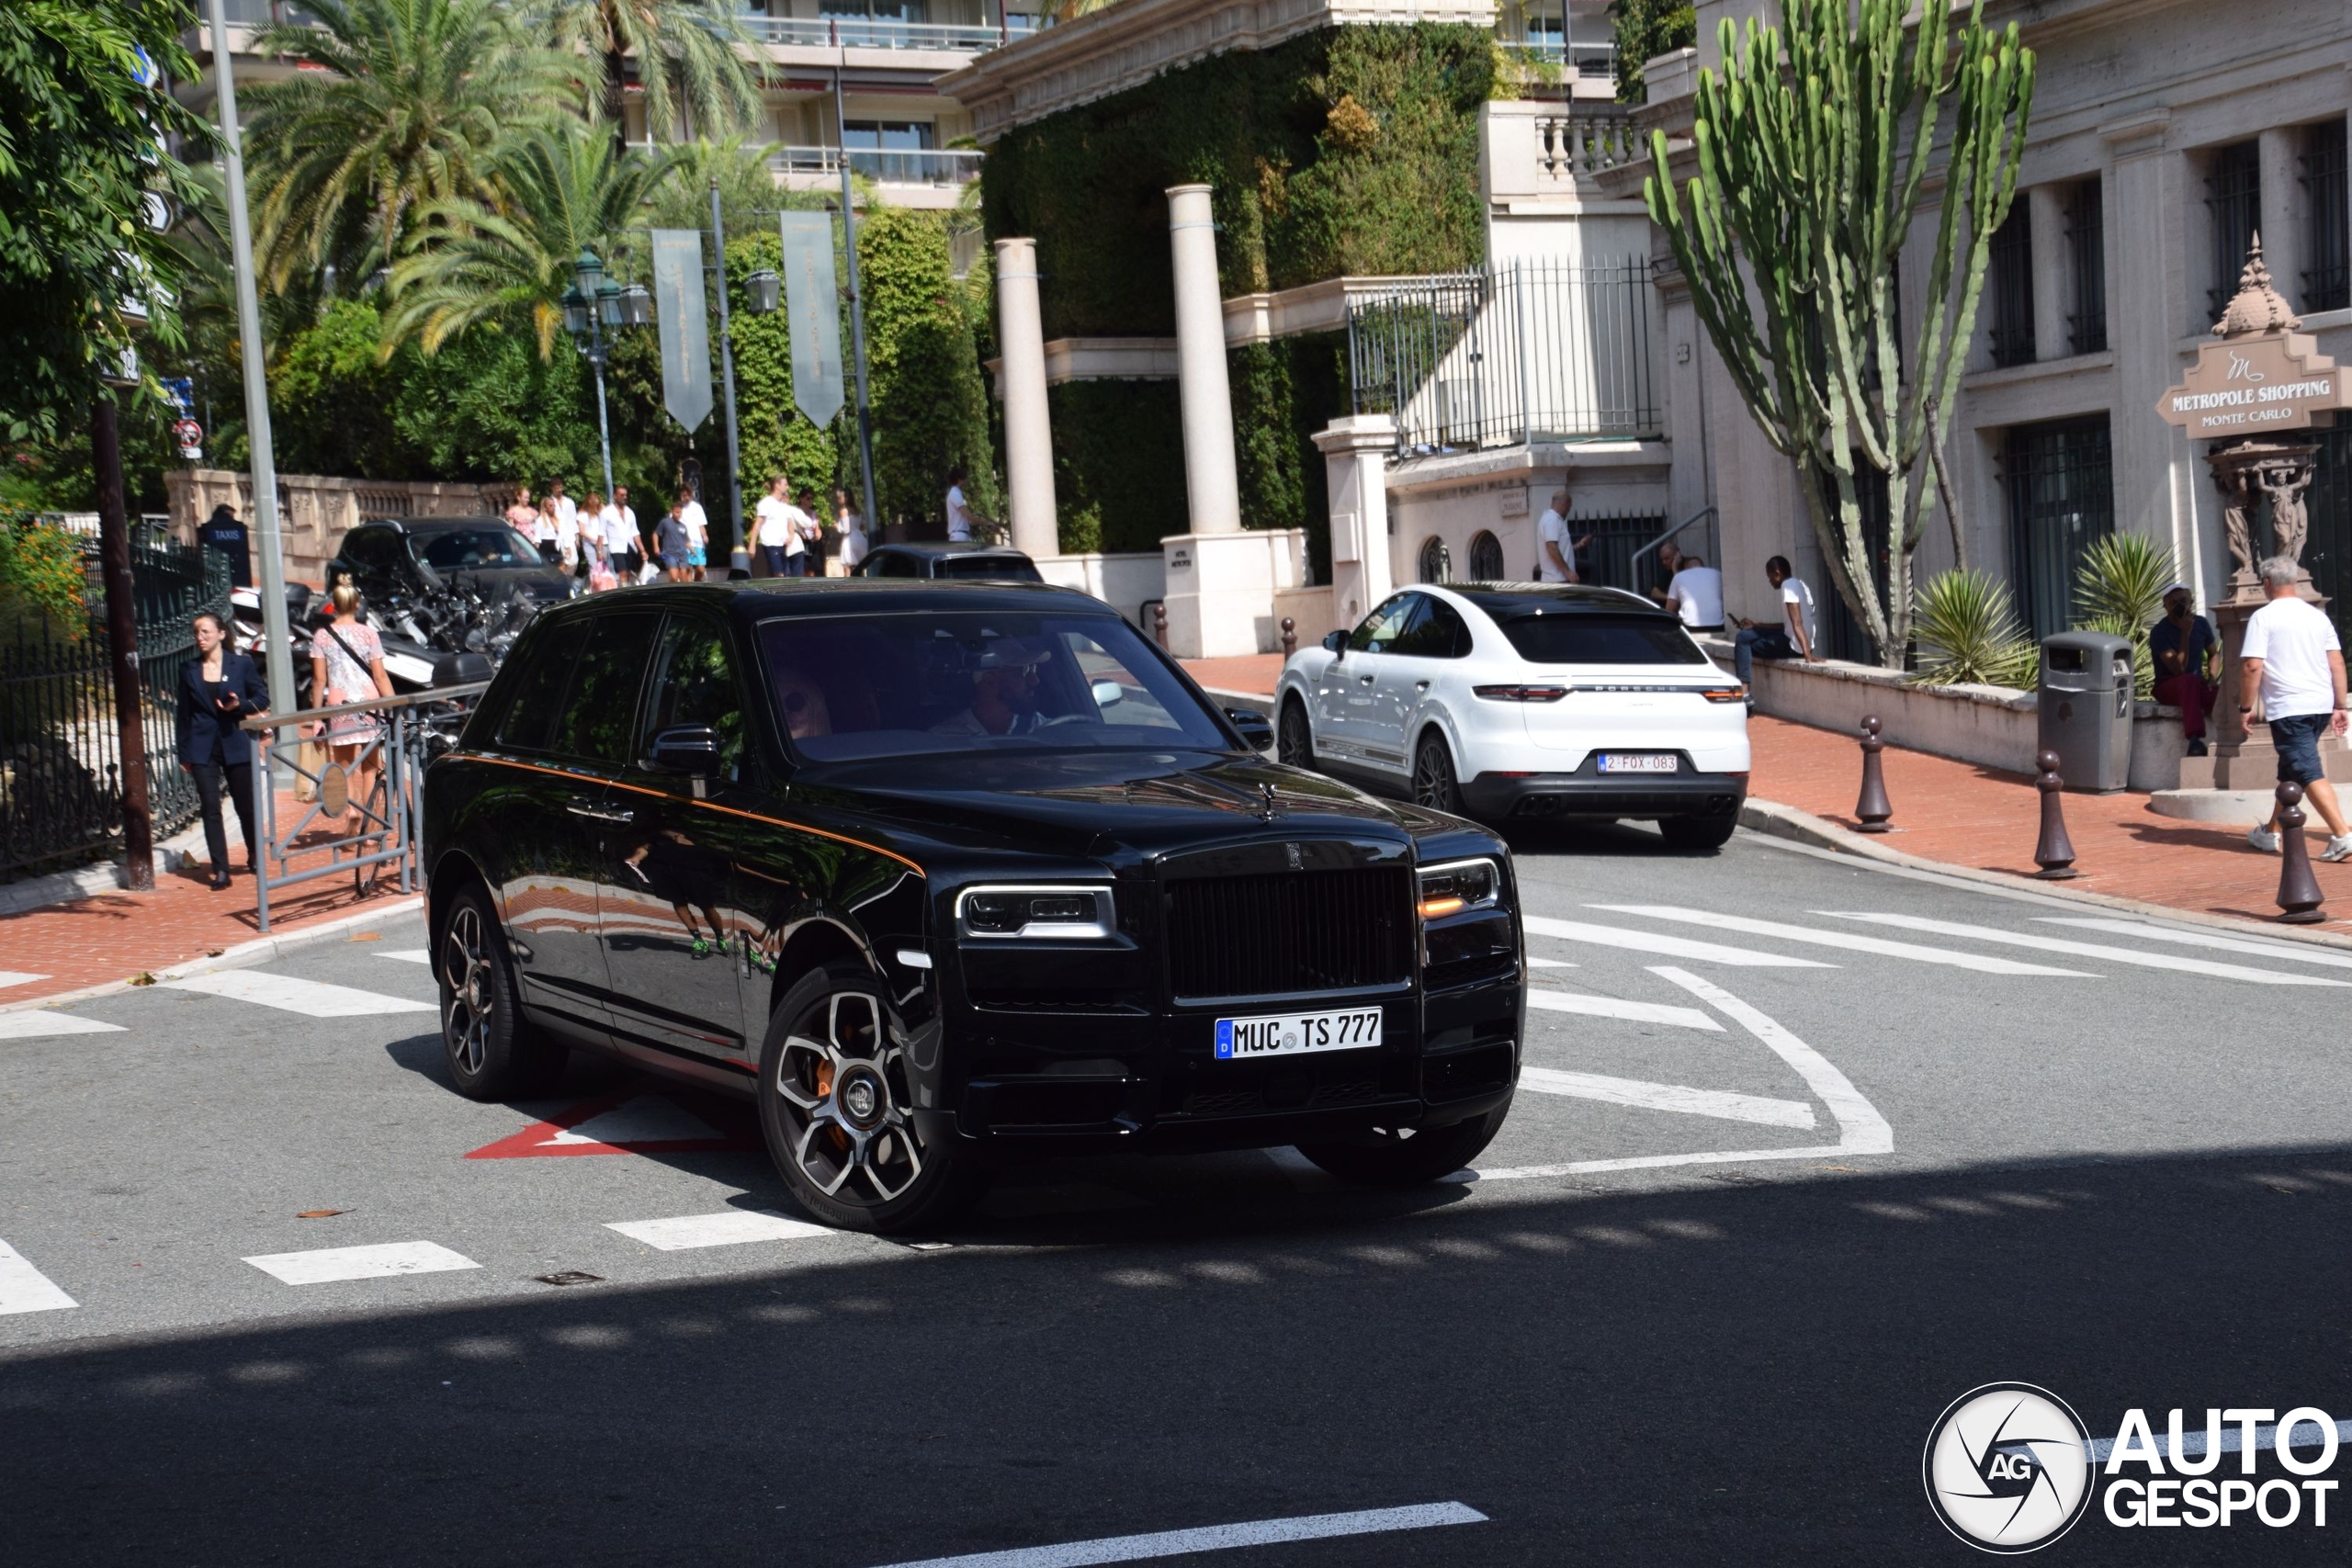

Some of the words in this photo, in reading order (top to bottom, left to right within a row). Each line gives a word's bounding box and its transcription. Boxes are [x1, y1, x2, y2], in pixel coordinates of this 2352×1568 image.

[2172, 388, 2256, 412] METROPOLE
[2258, 379, 2331, 402] SHOPPING
[2201, 412, 2245, 427] MONTE
[2248, 407, 2292, 423] CARLO
[214, 529, 239, 540] TAXIS
[1234, 1021, 1281, 1053] MUC
[1300, 1017, 1330, 1047] TS
[1337, 1012, 1380, 1043] 777
[1220, 1043, 1229, 1053] D
